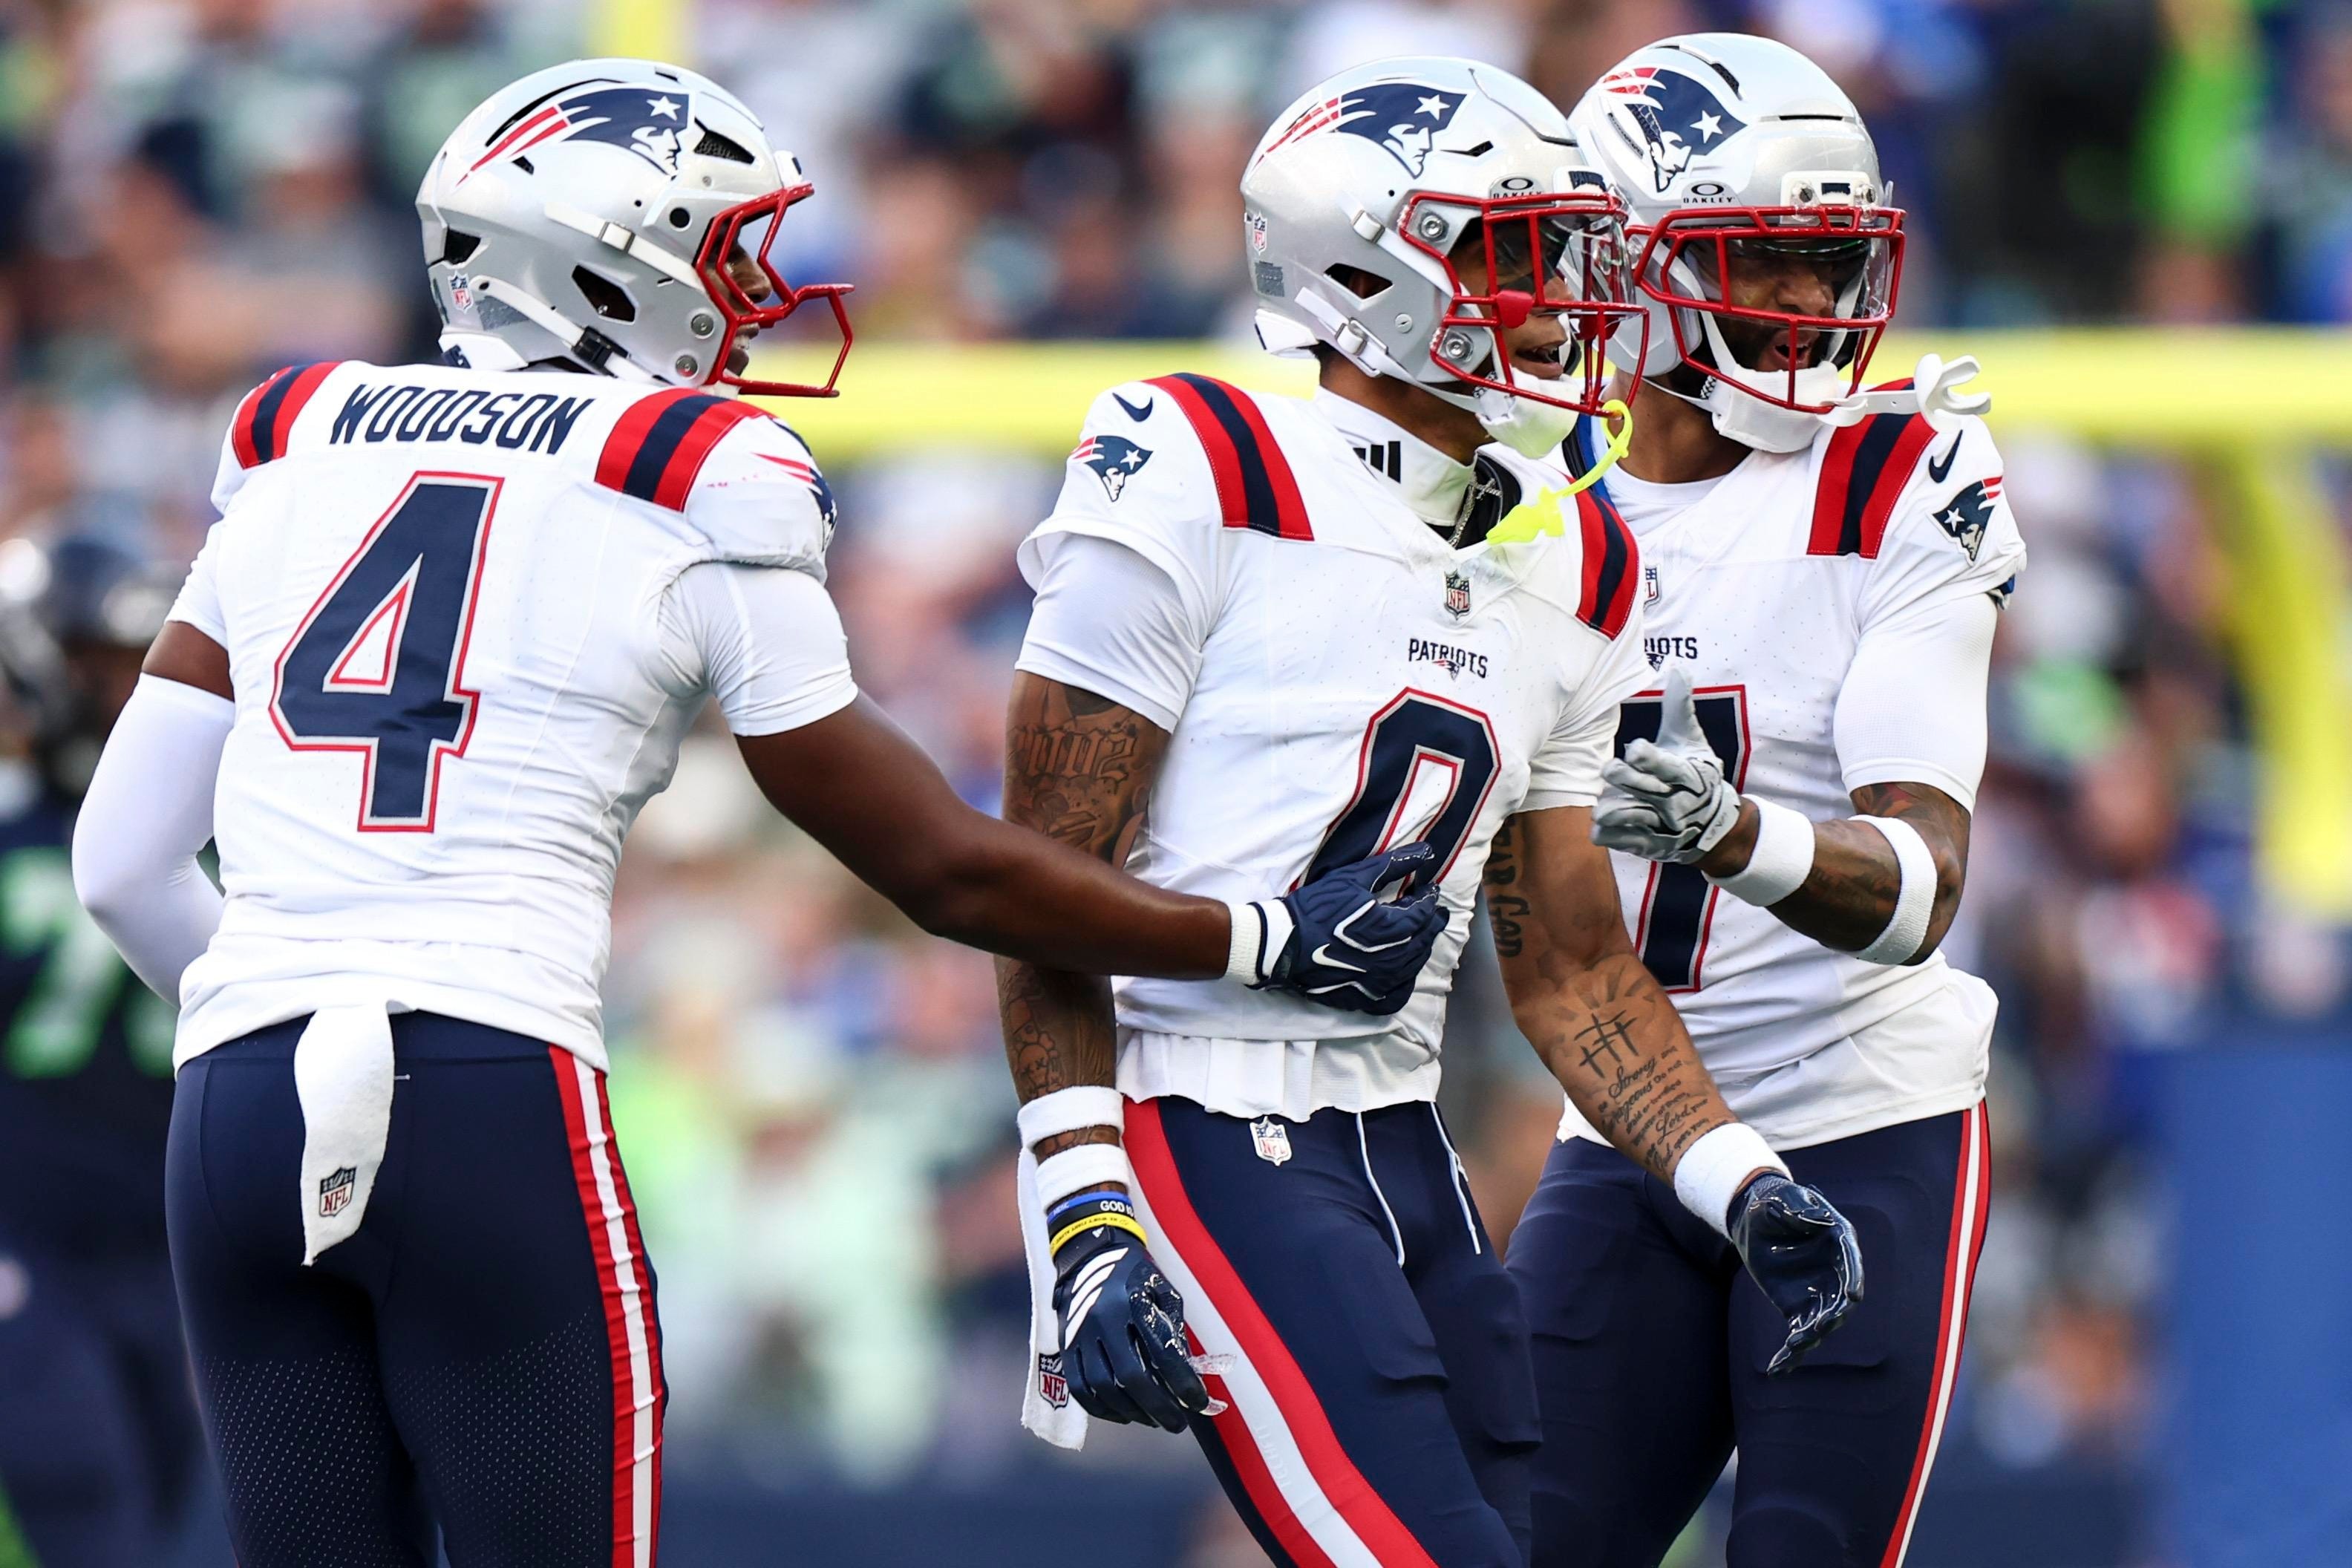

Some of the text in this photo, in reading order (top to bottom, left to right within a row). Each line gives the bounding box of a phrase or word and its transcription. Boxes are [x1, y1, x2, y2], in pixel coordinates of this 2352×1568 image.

[329, 385, 596, 455] WOODSON
[1448, 589, 1469, 610] NFL
[268, 470, 505, 833] 4
[1408, 638, 1489, 679] PATRIOTS
[1283, 686, 1501, 900] 0
[1608, 1057, 1656, 1101] Strong
[1656, 1104, 1690, 1145] Lord
[323, 1187, 349, 1212] NFL
[1100, 1200, 1125, 1212] GOD
[1042, 1373, 1067, 1402] NFL
